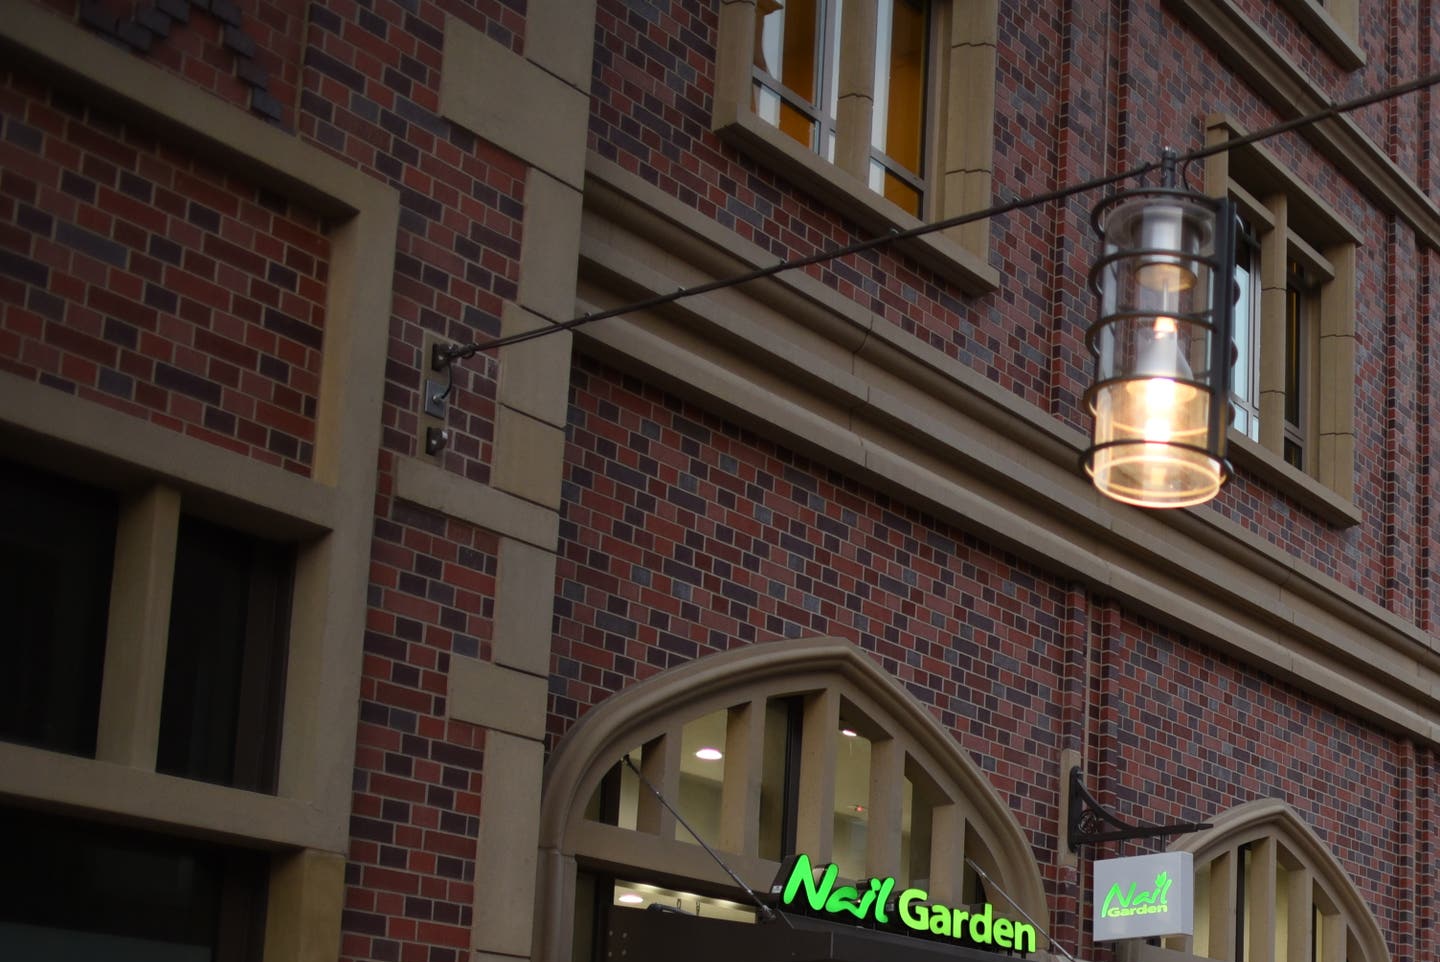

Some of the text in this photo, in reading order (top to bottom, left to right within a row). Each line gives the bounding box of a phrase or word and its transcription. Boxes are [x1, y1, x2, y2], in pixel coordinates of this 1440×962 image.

[783, 854, 1036, 953] Nail Garden
[1101, 872, 1172, 918] Nail
[1107, 904, 1168, 918] Garden
